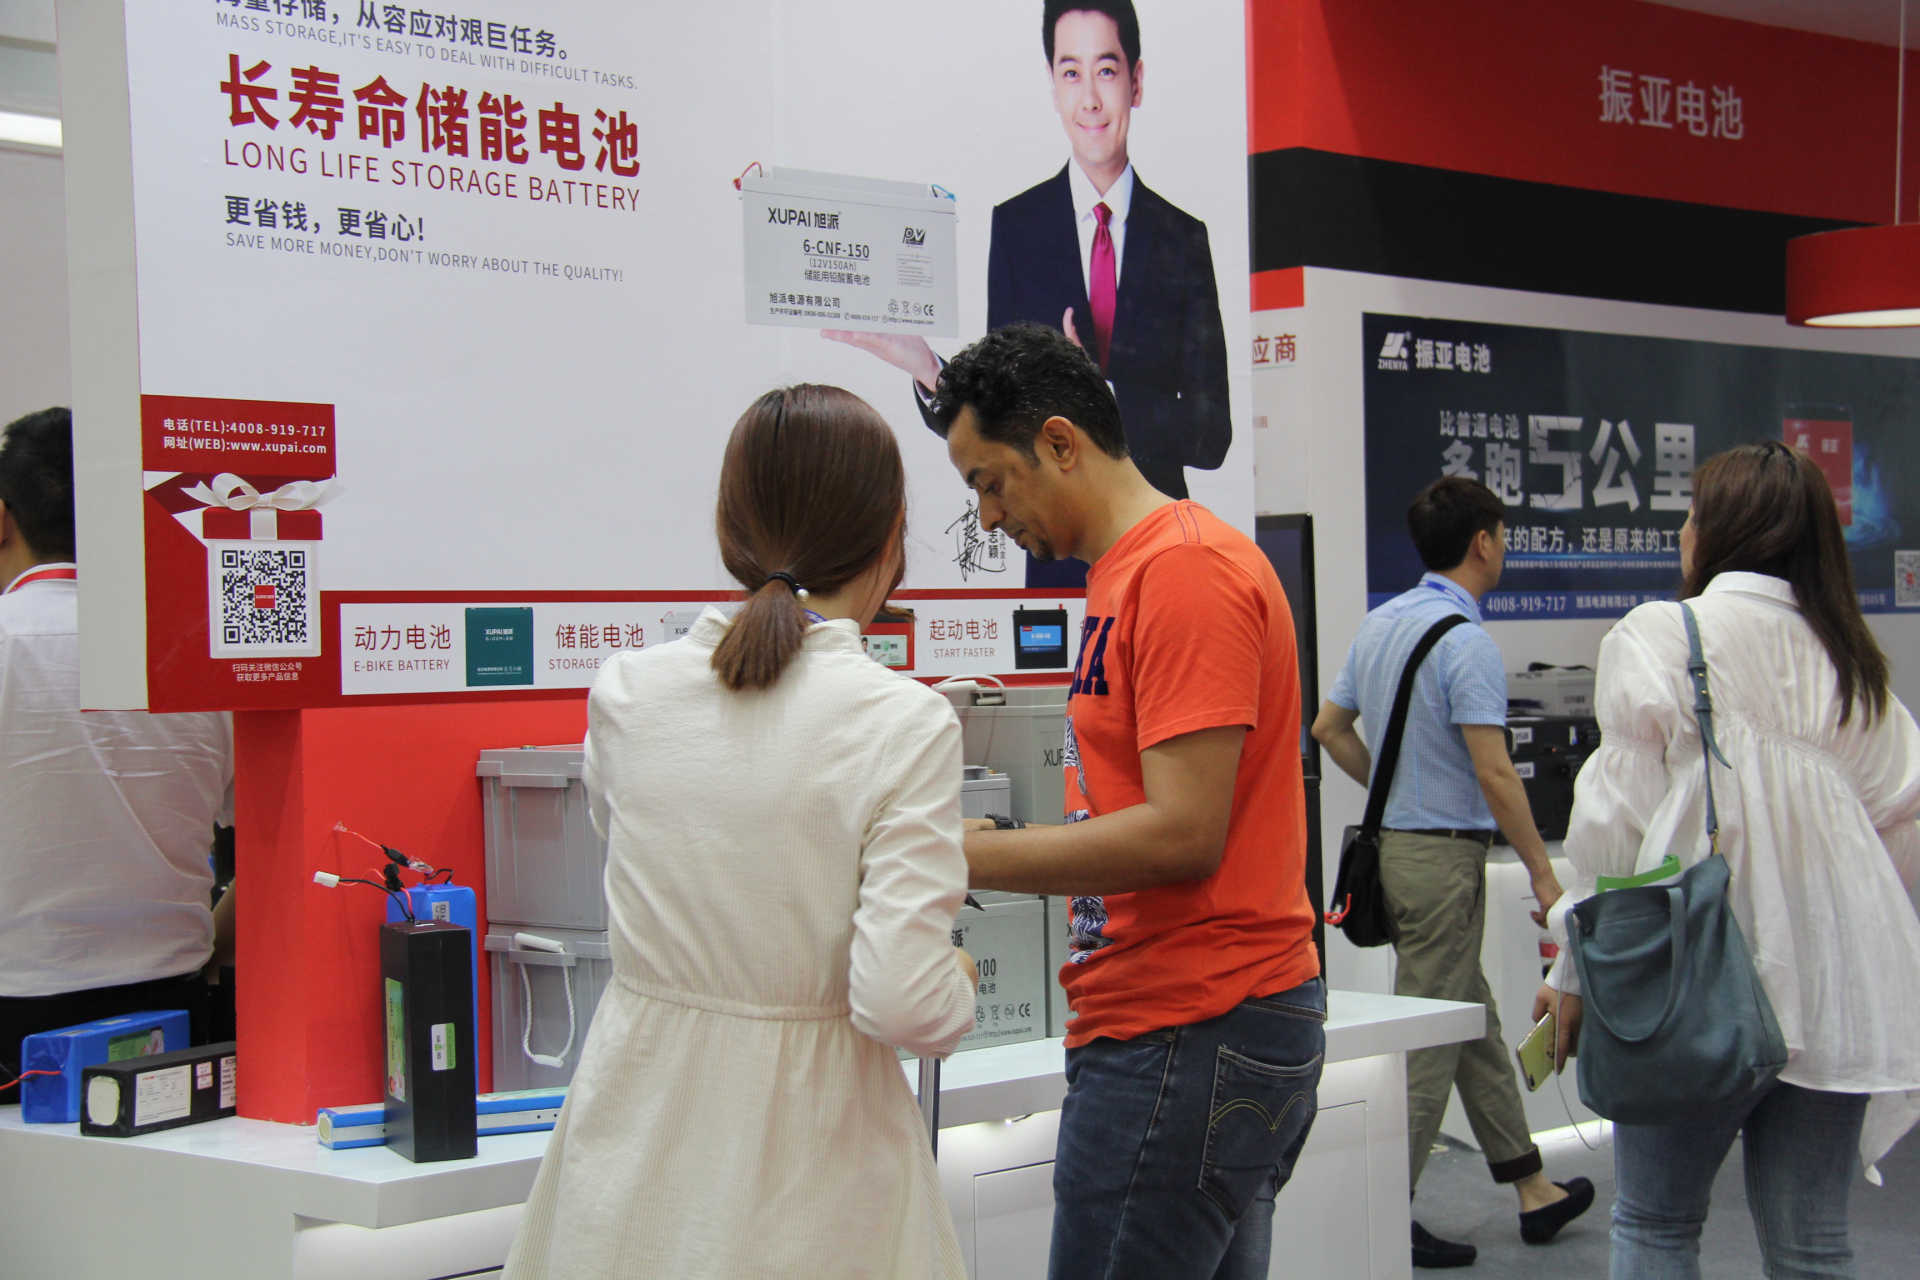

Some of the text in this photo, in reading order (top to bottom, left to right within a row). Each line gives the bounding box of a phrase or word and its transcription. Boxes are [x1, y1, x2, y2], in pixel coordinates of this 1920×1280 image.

[216, 0, 567, 60] 存储，从容应对艰巨任务。
[216, 12, 638, 90] MASS STORAGE,IT'S EASY TO DEAL WITH DIFFICULT TASKS.
[1598, 66, 1744, 140] 振亚电池
[219, 53, 640, 178] 长寿命储能电池
[224, 139, 640, 212] LONG LIFE STORAGE BATTERY
[768, 207, 811, 227] XUPAI
[226, 232, 624, 282] SAVE MORE MONEY,DON'T WORRY ABOUT THE QUALITY!
[803, 239, 870, 258] 6-CNF-150
[809, 257, 857, 271] (12V150Ah)
[1377, 358, 1408, 371] ZHENYA
[1415, 338, 1491, 373] 振亚电池
[163, 418, 326, 437] 电话(TEL):4008-919-717
[1440, 411, 1520, 440] 比普通电池
[163, 436, 327, 454] 网址(WEB):www.xupai.com
[1486, 596, 1566, 612] 4008-919-717
[354, 624, 452, 651] 动力电池
[556, 623, 644, 649] 储能电池
[929, 618, 998, 641] 起动电池
[934, 647, 996, 658] START FASTER
[354, 658, 450, 673] E-BIKE BATTERY
[549, 658, 600, 671] STORAGE
